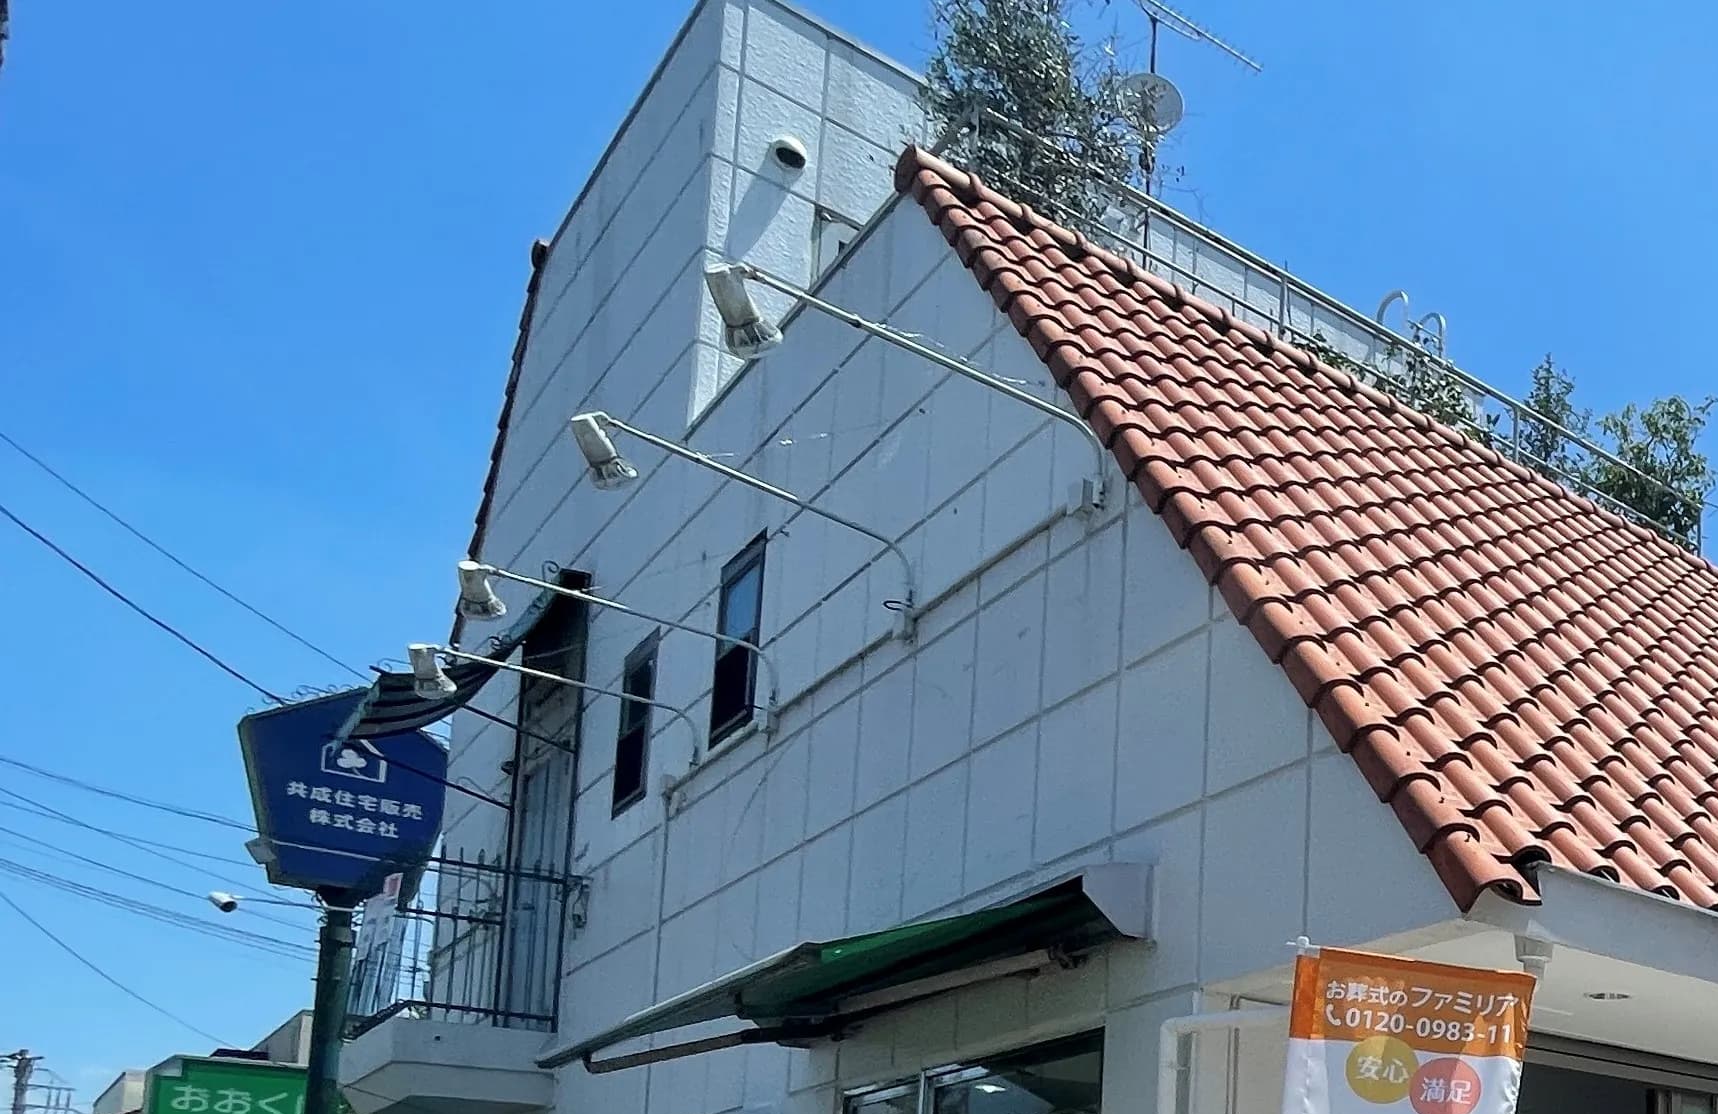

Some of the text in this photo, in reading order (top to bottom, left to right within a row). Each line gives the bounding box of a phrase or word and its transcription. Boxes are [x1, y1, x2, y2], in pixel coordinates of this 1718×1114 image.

[286, 780, 423, 821] 共成住宅販売
[309, 807, 400, 839] 株式会社
[1326, 980, 1519, 1018] お葬式のファミリア
[1345, 1007, 1512, 1044] 0120-0983-11
[1356, 1056, 1410, 1083] 安心
[1419, 1077, 1472, 1105] 満足
